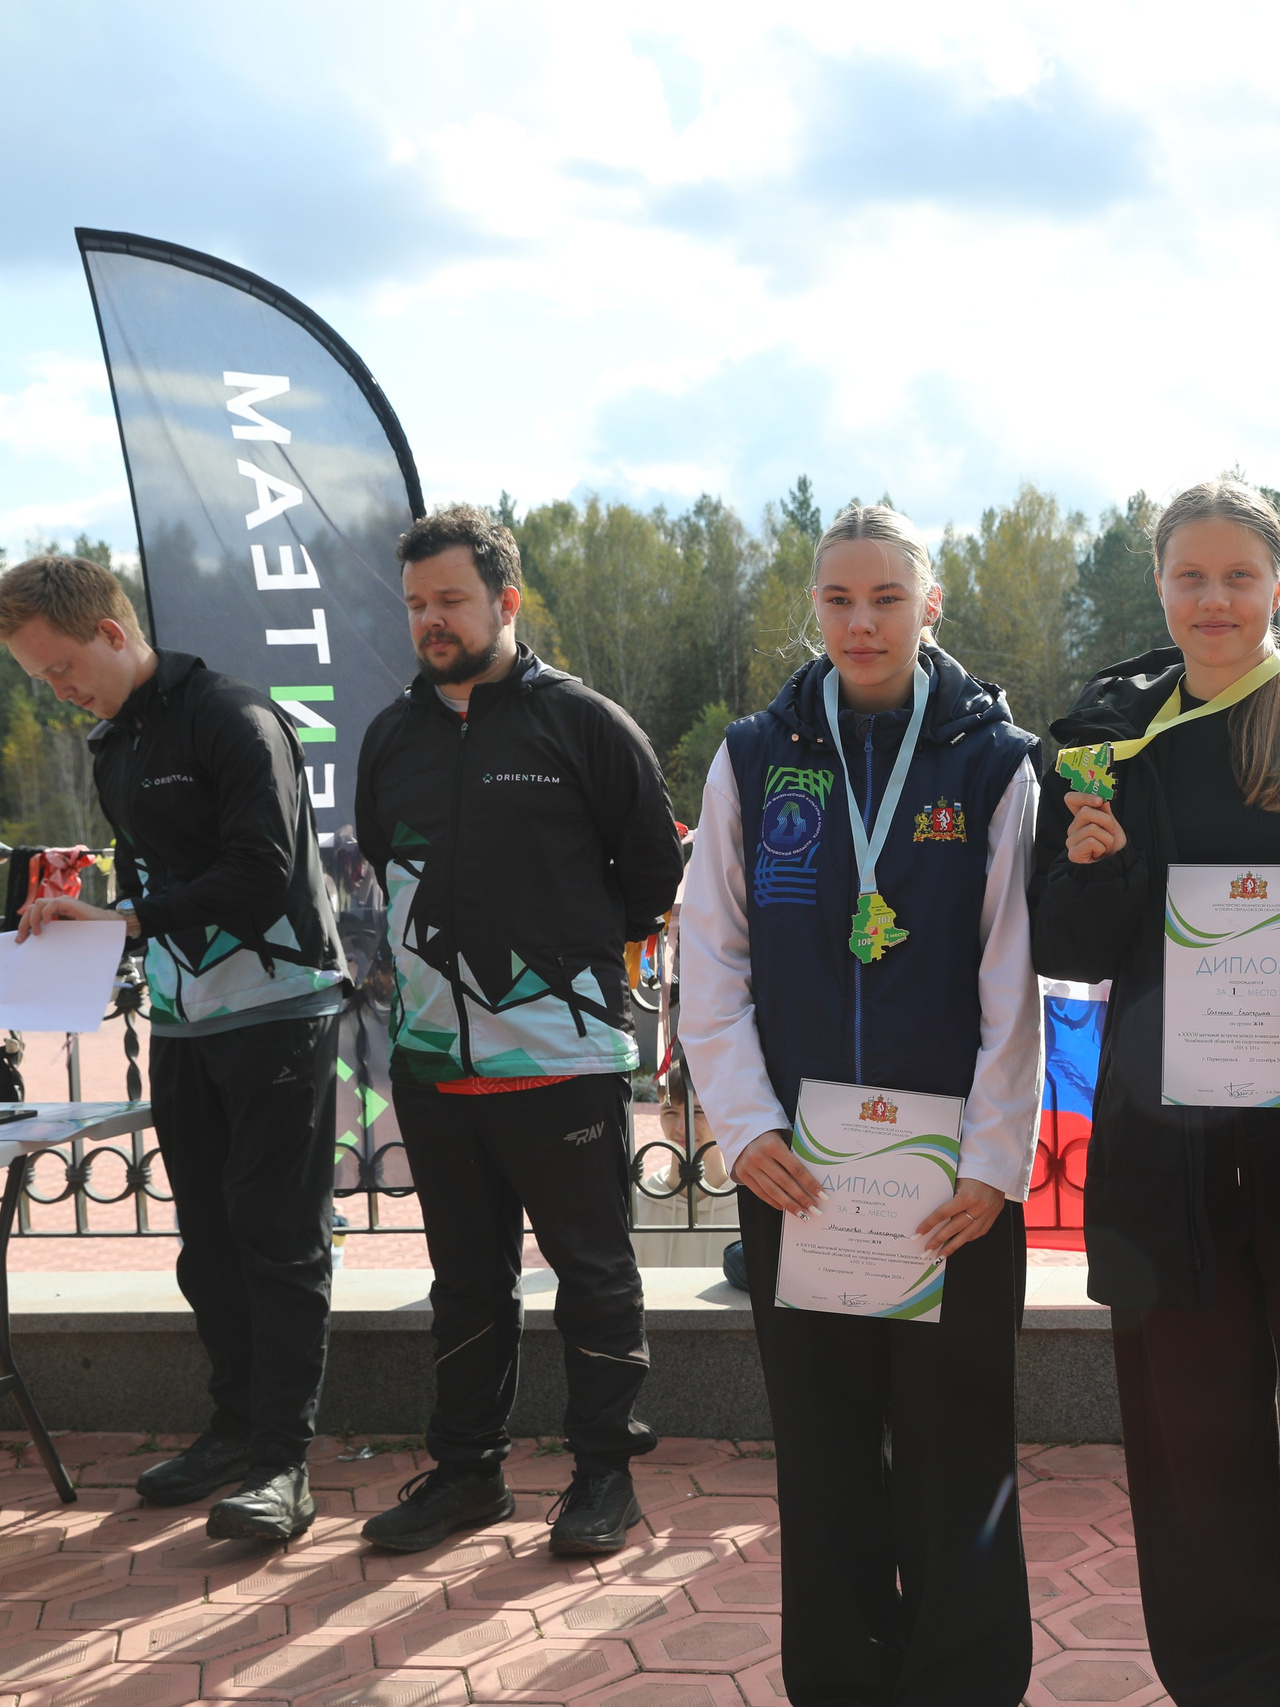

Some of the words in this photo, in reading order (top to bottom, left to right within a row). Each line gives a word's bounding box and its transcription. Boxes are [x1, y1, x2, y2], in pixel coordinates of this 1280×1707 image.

[496, 774, 560, 783] ORIENTEAM
[877, 916, 891, 924] 101
[857, 938, 871, 946] 101
[1238, 1008, 1271, 1017] Екатерина
[564, 1120, 604, 1146] RAY
[821, 1173, 920, 1200] ДИПЛОМ
[868, 1210, 897, 1218] МЕСТО
[888, 1257, 925, 1266] ориентированию
